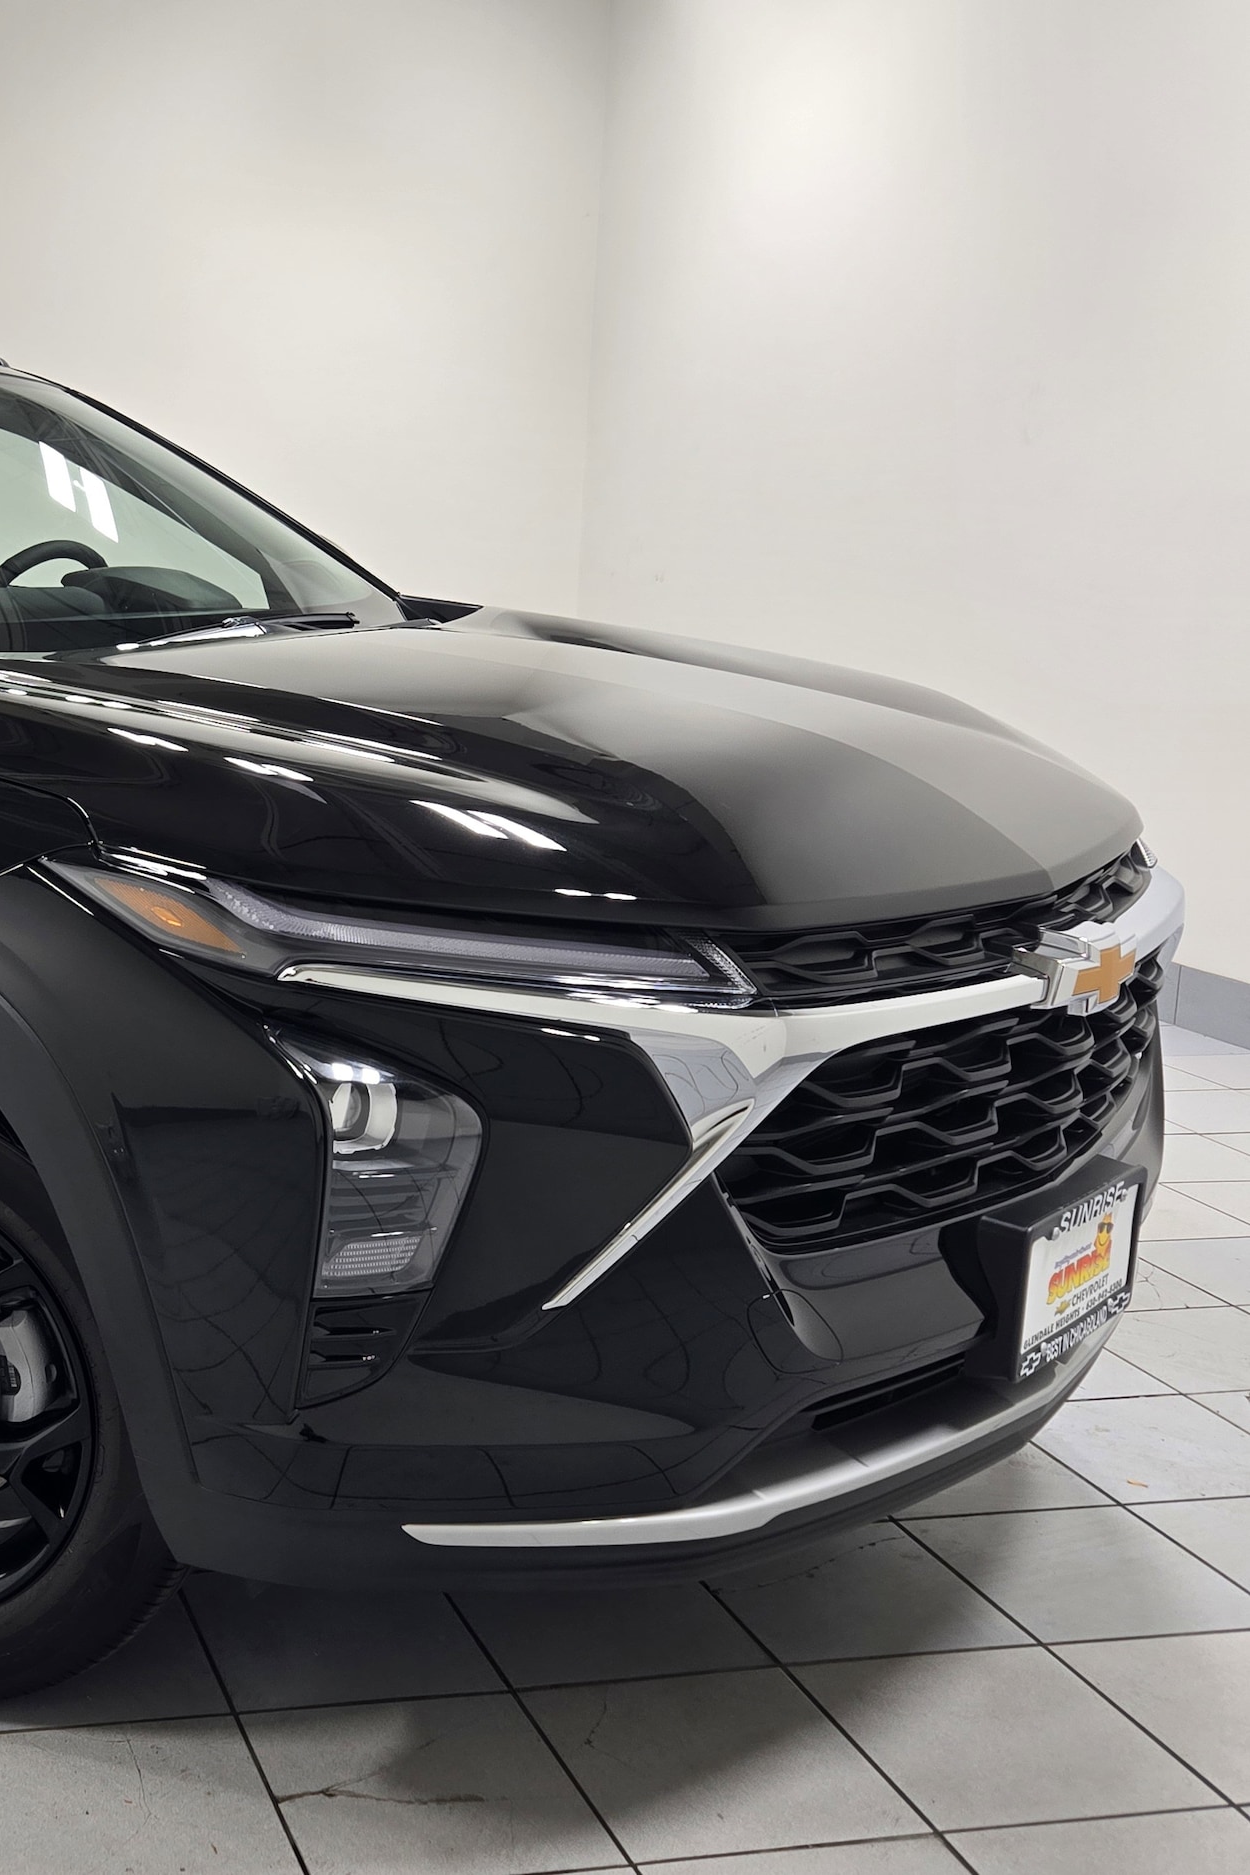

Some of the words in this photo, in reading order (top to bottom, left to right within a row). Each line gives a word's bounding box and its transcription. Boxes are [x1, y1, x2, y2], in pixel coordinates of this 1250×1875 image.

[1060, 1180, 1125, 1233] SUNRISE
[1071, 1273, 1109, 1307] CHEVROLET
[1023, 1322, 1054, 1350] GLENDALE
[1055, 1306, 1080, 1331] HEIGHTS
